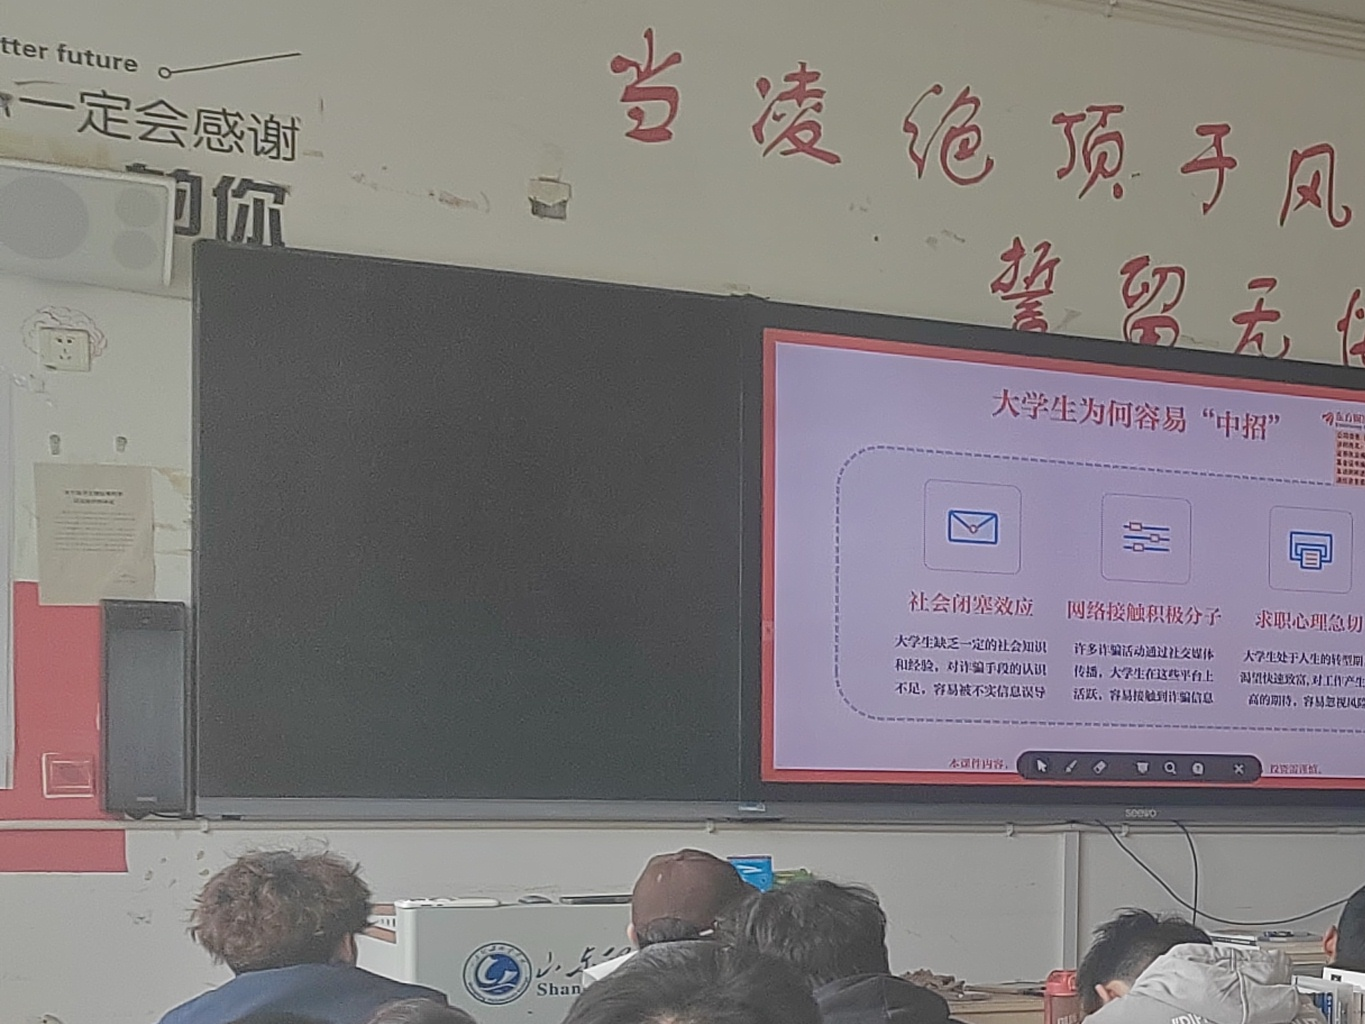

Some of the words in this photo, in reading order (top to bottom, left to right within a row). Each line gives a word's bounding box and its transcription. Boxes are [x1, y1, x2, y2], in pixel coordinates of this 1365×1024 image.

[57, 43, 138, 72] future
[0, 90, 300, 161] 一定会感谢
[992, 389, 1281, 442] 大学生为何容易“中招”
[909, 591, 1033, 617] 社会闭塞效应
[1067, 600, 1222, 626] 网络接触积极分子
[1255, 610, 1363, 633] 求职心理急切
[894, 635, 1047, 654] 大学生缺乏一定的社会知识
[1074, 642, 1214, 660] 许多诈骗活动通过社交媒体
[537, 983, 582, 996] Shan
